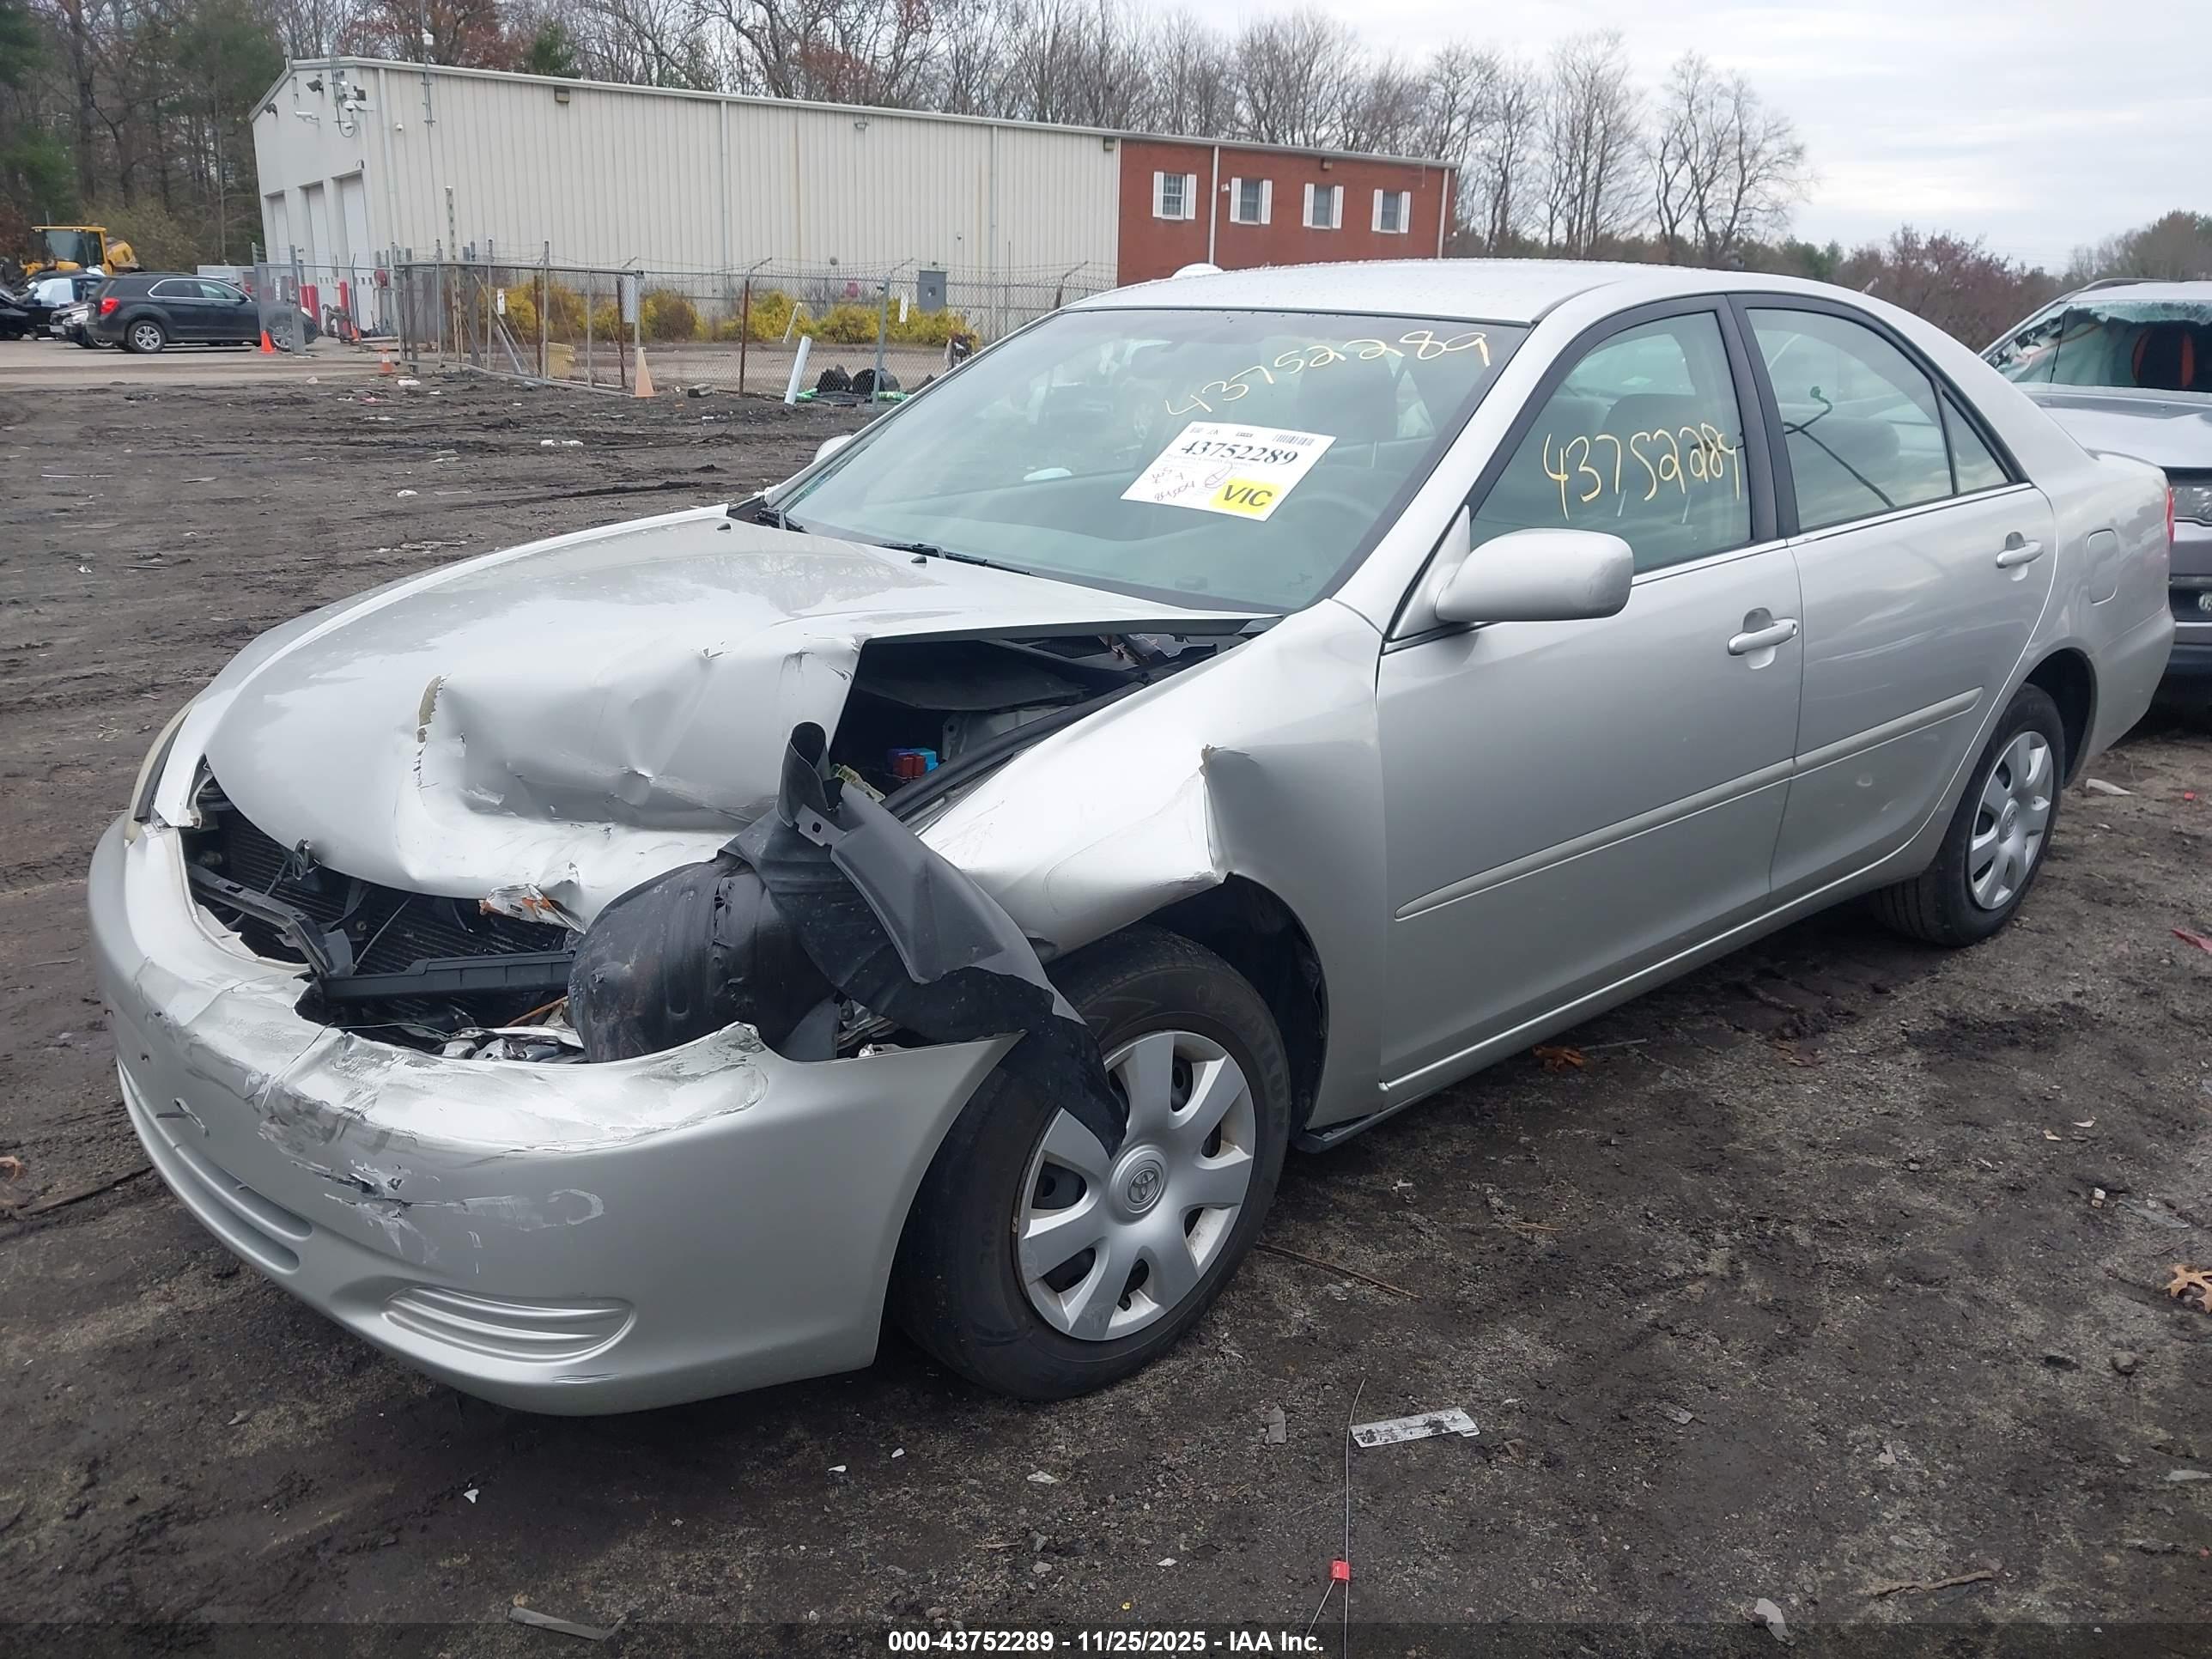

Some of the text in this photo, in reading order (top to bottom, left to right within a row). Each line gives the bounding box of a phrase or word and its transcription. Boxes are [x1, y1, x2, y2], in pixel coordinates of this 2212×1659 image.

[1164, 330, 1491, 416] 43752289
[1181, 440, 1299, 465] 43752289
[1543, 422, 1741, 522] 43752289
[1224, 484, 1273, 507] VIC
